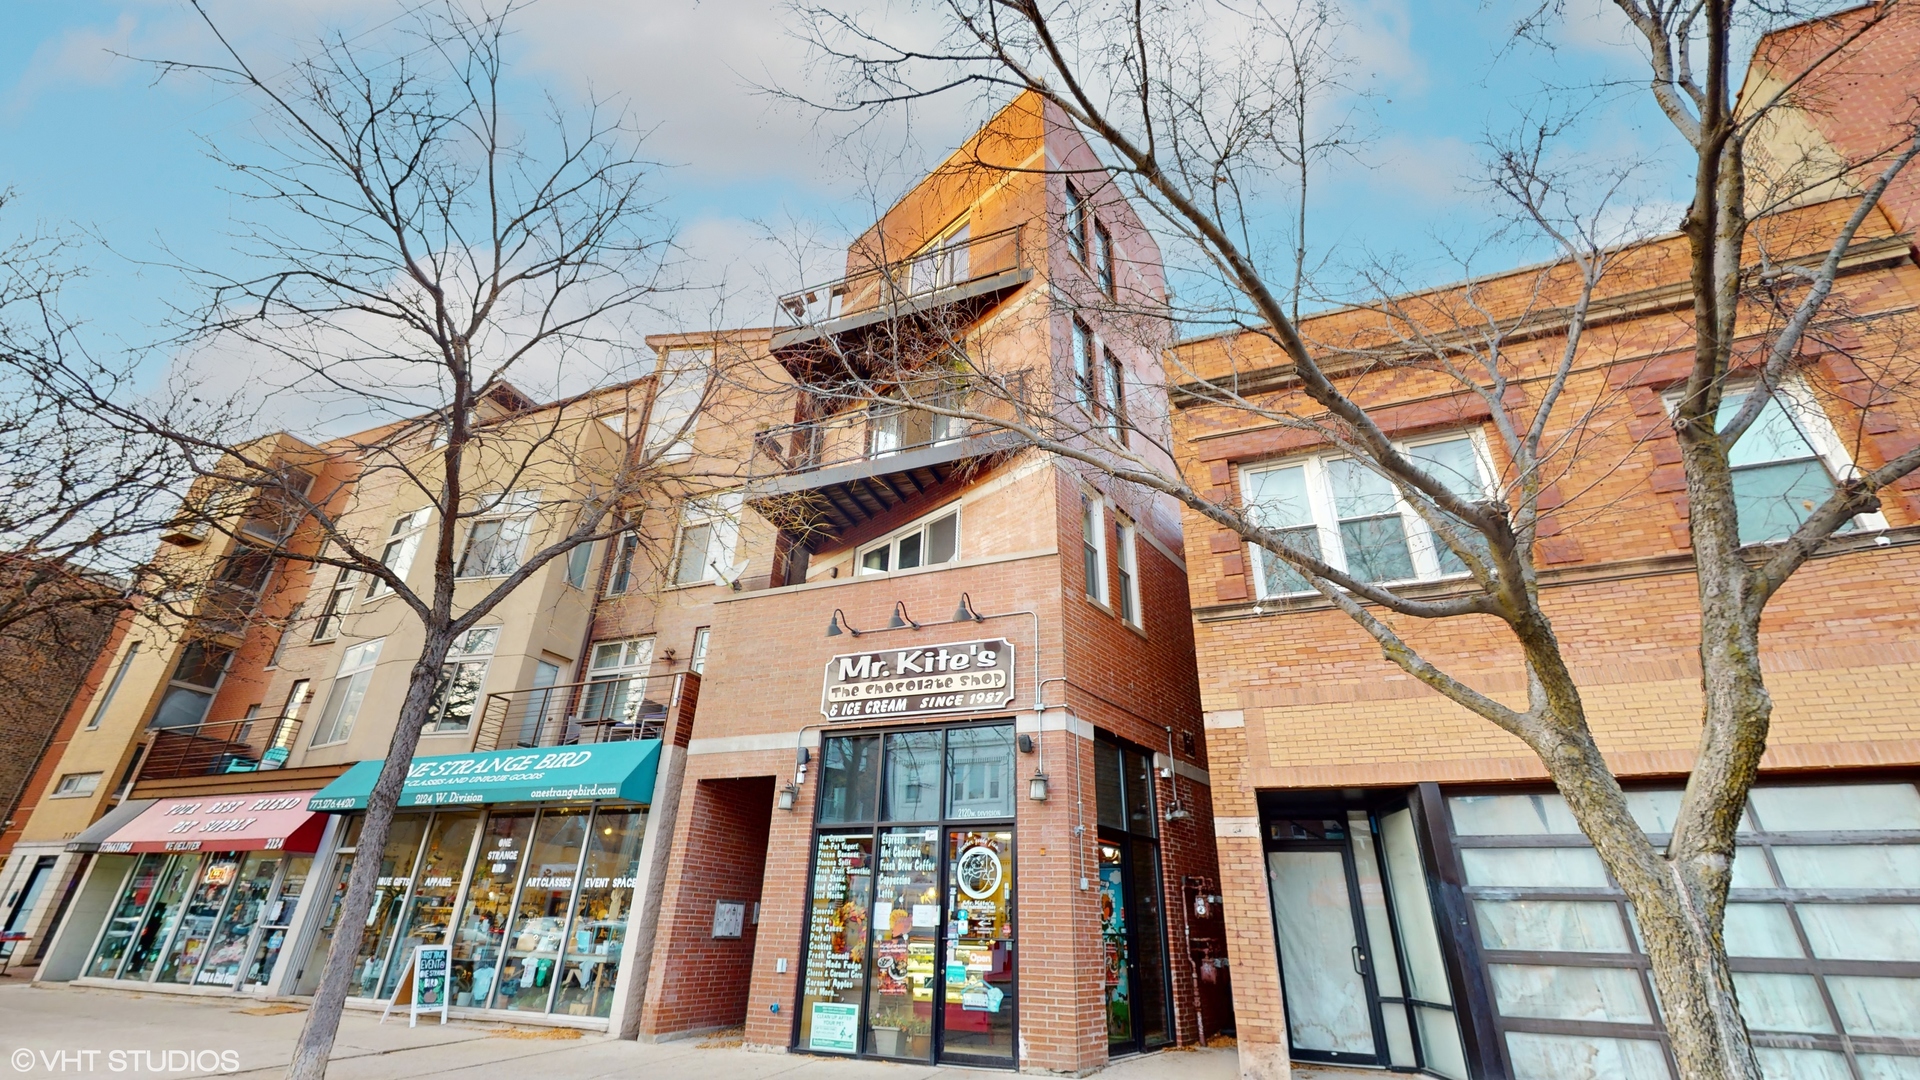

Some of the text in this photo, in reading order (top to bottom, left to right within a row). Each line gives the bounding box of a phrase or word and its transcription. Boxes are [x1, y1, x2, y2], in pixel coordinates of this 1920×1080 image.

[838, 645, 997, 681] Mr. Kite's
[831, 684, 859, 698] The
[960, 672, 1002, 688] Shop
[830, 692, 1004, 716] & ICE CREAM SINCE 1987
[407, 751, 592, 778] NE STRANGE BIRD
[408, 778, 446, 787] CLASSES
[444, 776, 469, 785] AND
[469, 774, 509, 783] UNIQUE
[509, 772, 545, 781] GOODS
[531, 784, 616, 799] onestrangebird.com
[415, 791, 483, 804] 2124 W. Division
[164, 797, 301, 816] YOUR BEST FRIEND
[309, 798, 355, 809] 773.276.4420
[168, 817, 257, 833] PET SUPPLY
[264, 838, 285, 849] 2124
[498, 838, 512, 847] ONE
[881, 833, 906, 846] Espresso
[174, 841, 202, 851] DELIVER
[487, 850, 518, 860] STRANGE
[817, 850, 836, 858] Frozen
[881, 846, 921, 858] Hot Chocolate
[491, 863, 507, 873] BIRD
[816, 866, 831, 874] Fresh
[880, 858, 936, 872] Fresh Brew Coffee
[393, 876, 411, 887] GIFTS
[425, 877, 452, 887] APPAREL
[585, 877, 637, 888] EVENT SPACE
[815, 874, 827, 882] Milk
[879, 873, 911, 887] Cappuccino
[827, 882, 846, 891] Coffee
[878, 888, 894, 899] Latte
[811, 924, 822, 933] Cup
[810, 933, 831, 941] Parfait
[809, 942, 832, 950] Cookies
[808, 950, 850, 960] Fresh Cannoli
[970, 953, 991, 963] Open
[421, 959, 441, 970] EVENT
[807, 959, 862, 971] Home-Made Fudge
[829, 969, 850, 978] Caramel
[805, 978, 853, 989] Caramel Apples
[805, 987, 817, 995] And
